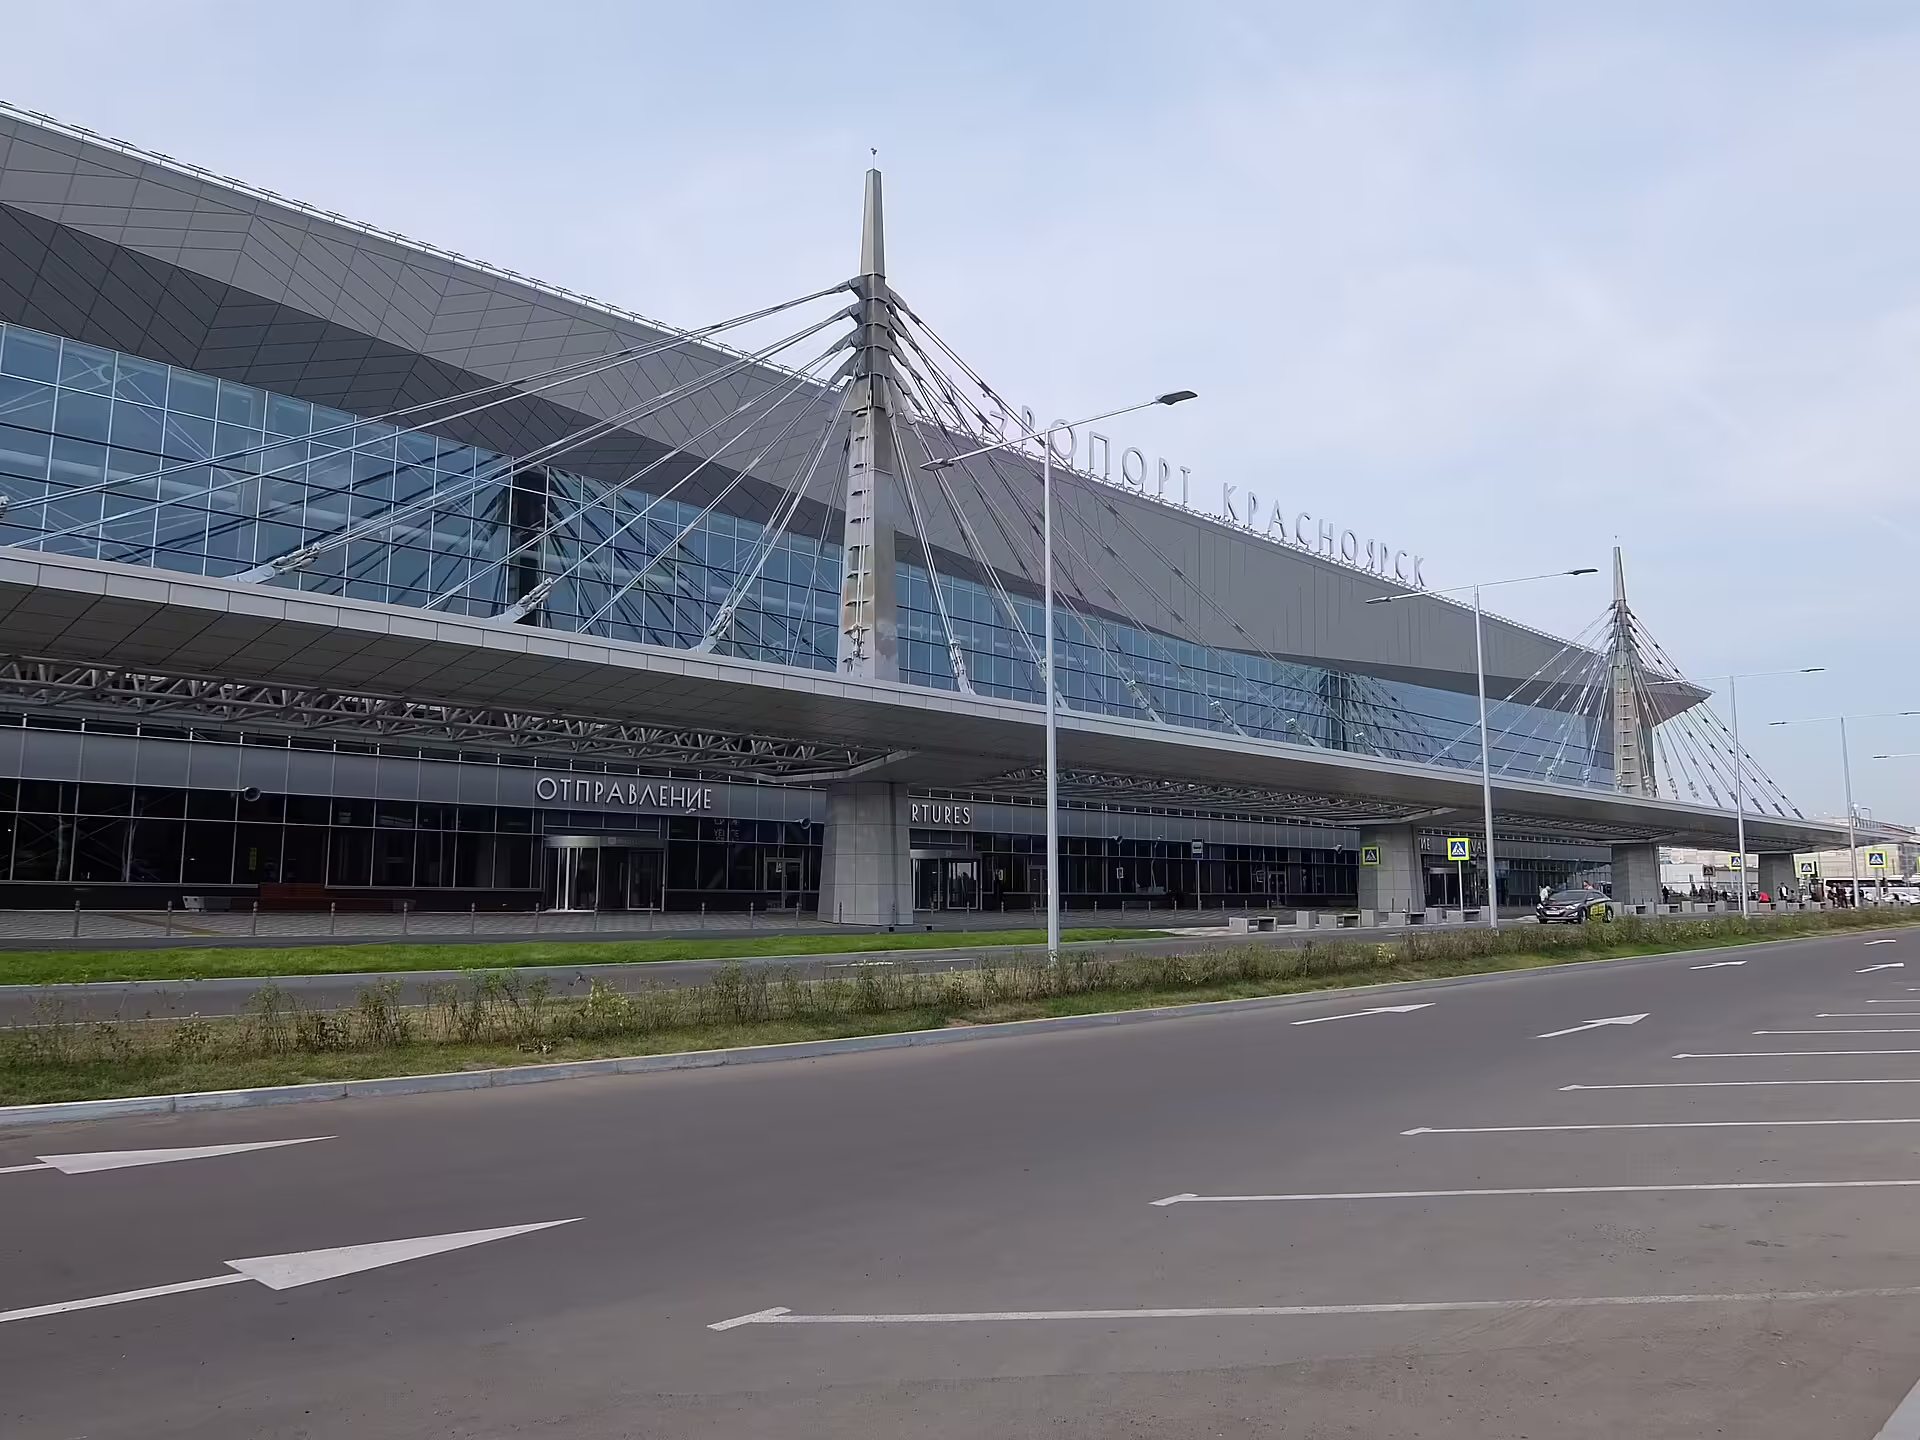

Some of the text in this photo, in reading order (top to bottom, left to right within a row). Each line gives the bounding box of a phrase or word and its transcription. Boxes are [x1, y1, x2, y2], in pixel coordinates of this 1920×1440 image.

[1223, 482, 1425, 586] КРАСНОЯРСК
[537, 777, 712, 810] ОТПРАВЛЕНИЕ
[911, 803, 971, 825] RTURES
